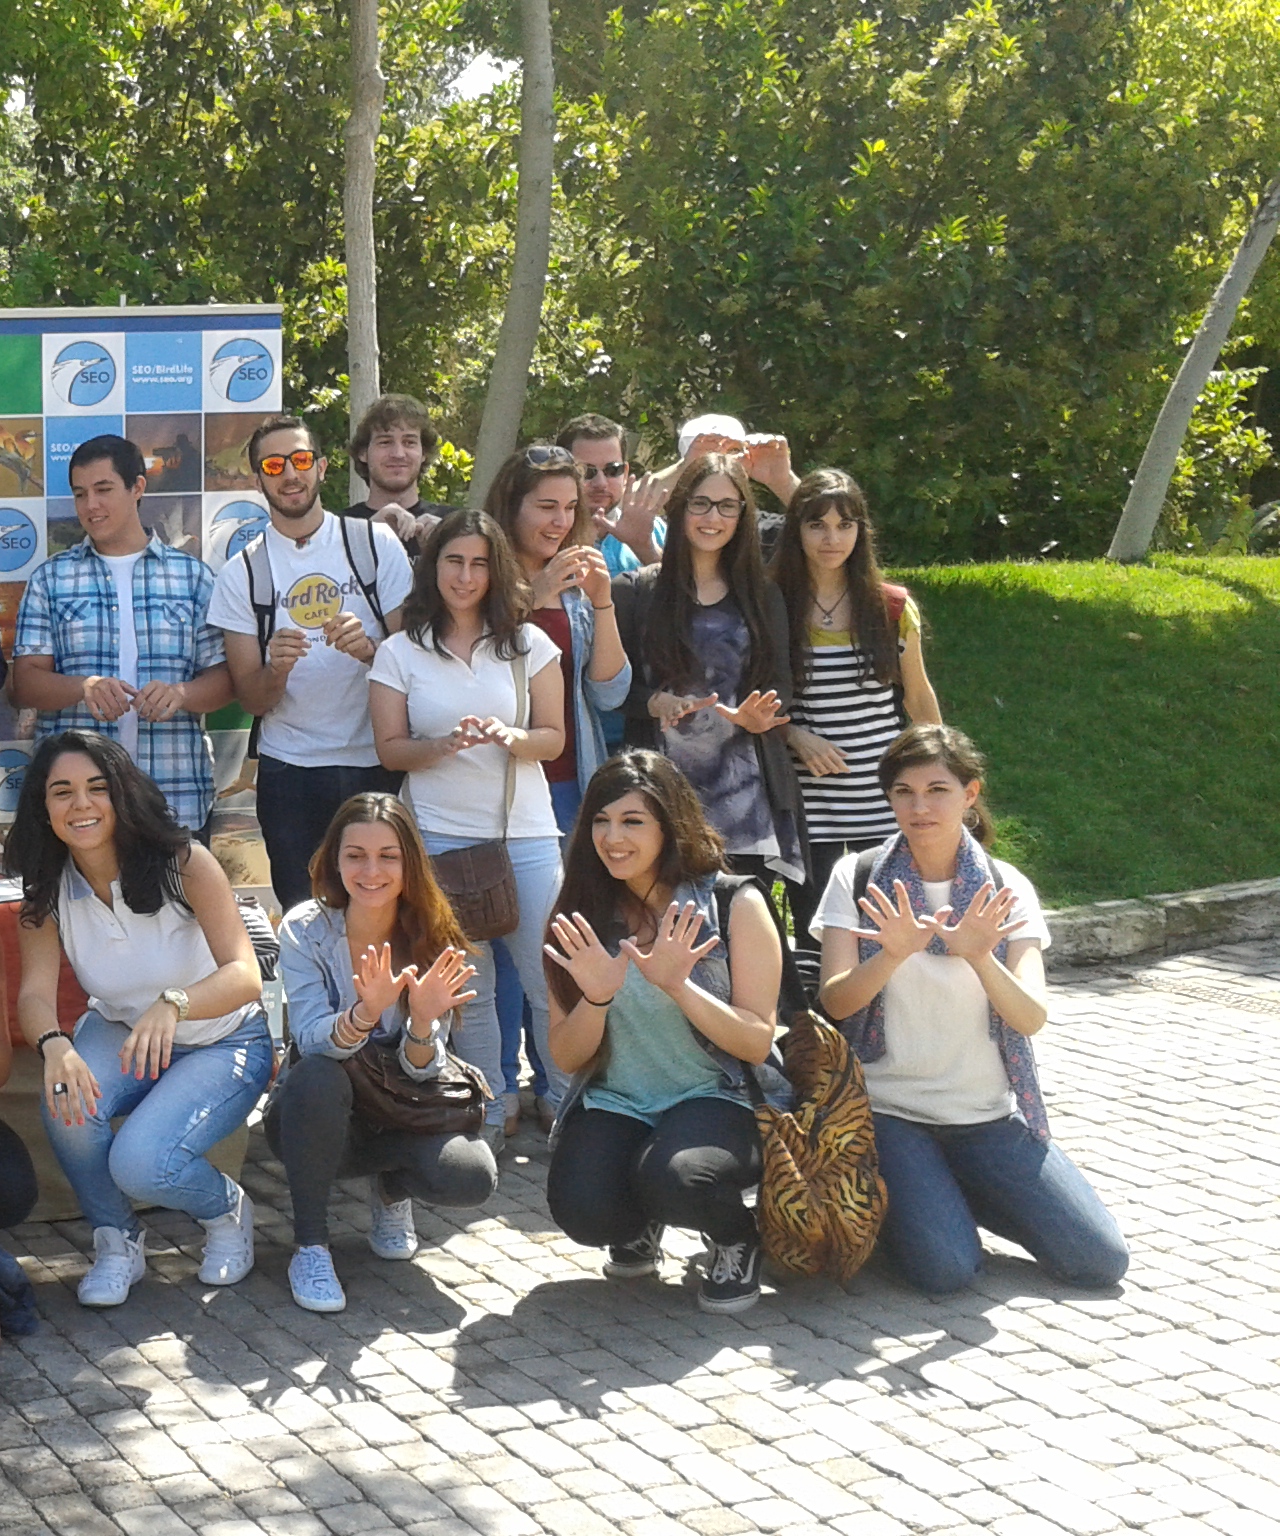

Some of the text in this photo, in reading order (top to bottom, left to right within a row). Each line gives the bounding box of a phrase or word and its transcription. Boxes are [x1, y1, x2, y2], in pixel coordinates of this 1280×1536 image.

[132, 364, 194, 375] SEO/BirdLife
[238, 367, 268, 381] SEO
[81, 371, 110, 384] SEO
[132, 375, 193, 385] www.seo.org
[1, 537, 32, 550] SEO
[314, 575, 363, 605] Rock
[304, 607, 330, 621] CAFE
[5, 777, 23, 790] SE
